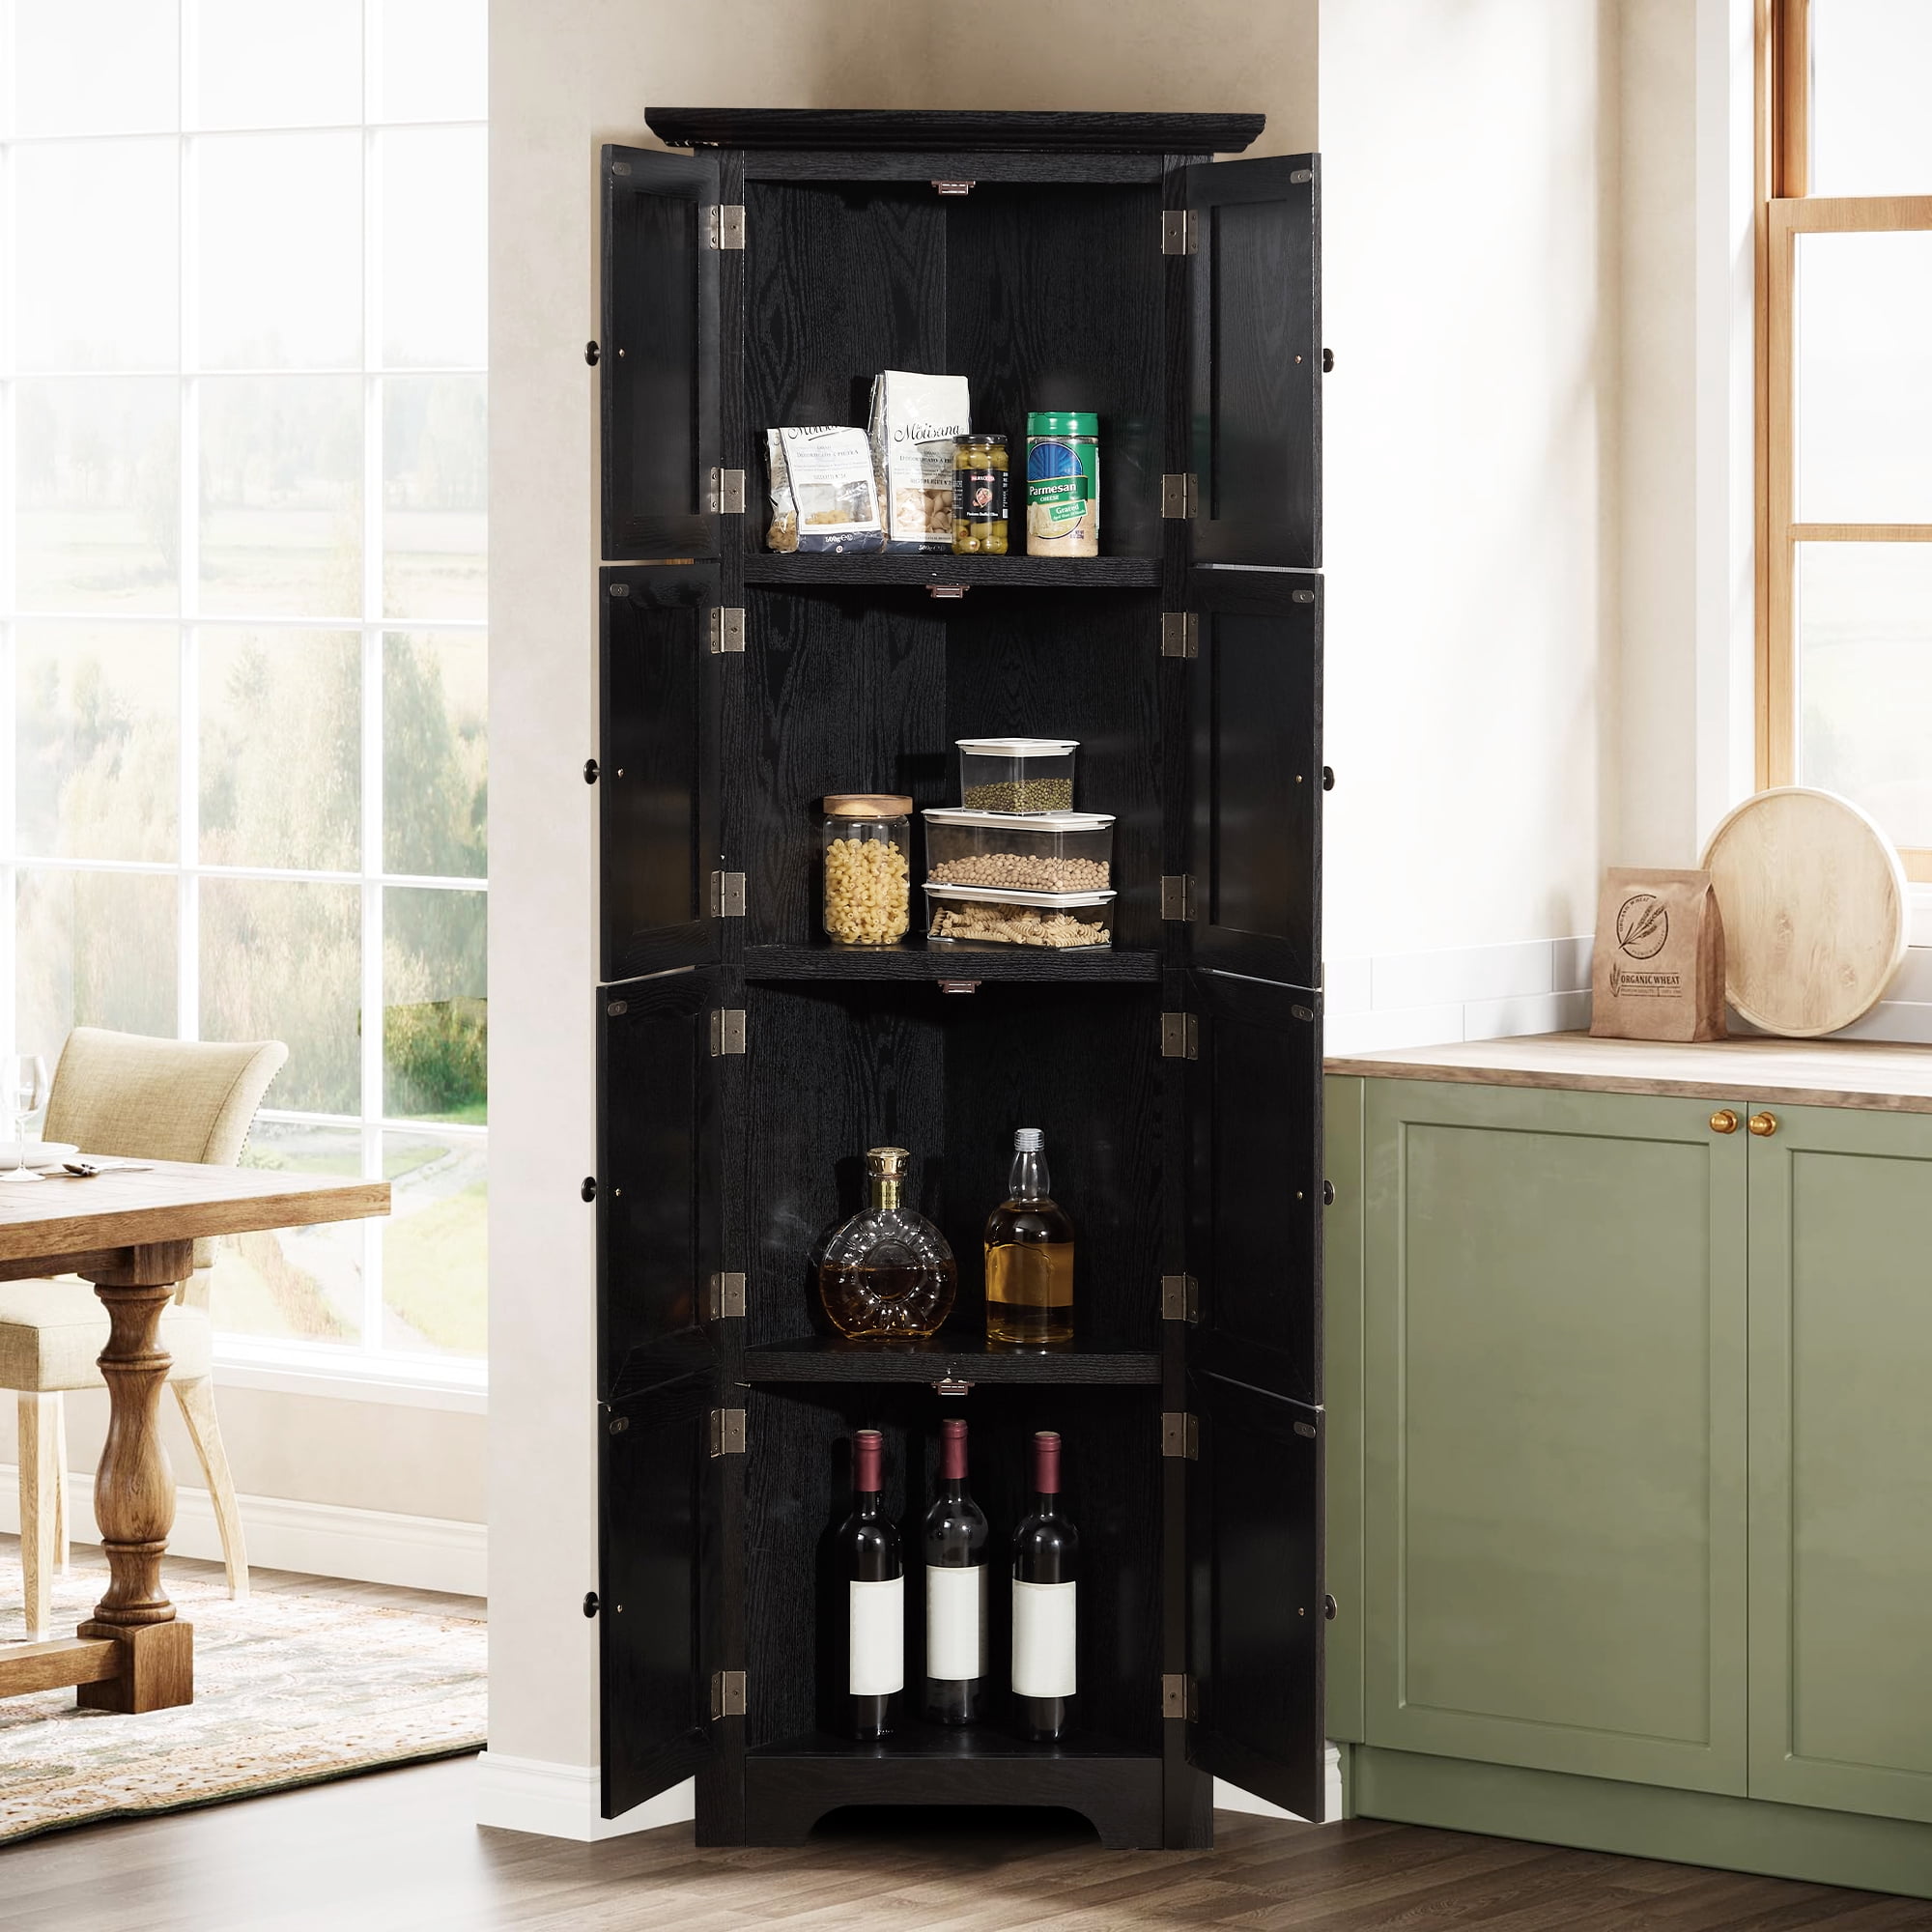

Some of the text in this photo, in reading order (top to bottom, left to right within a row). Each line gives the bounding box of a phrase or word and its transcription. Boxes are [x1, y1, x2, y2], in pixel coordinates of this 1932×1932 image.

[1029, 483, 1076, 496] Parmesan
[1056, 503, 1079, 514] Grated
[1621, 975, 1680, 984] ORGANIC WHEAT
